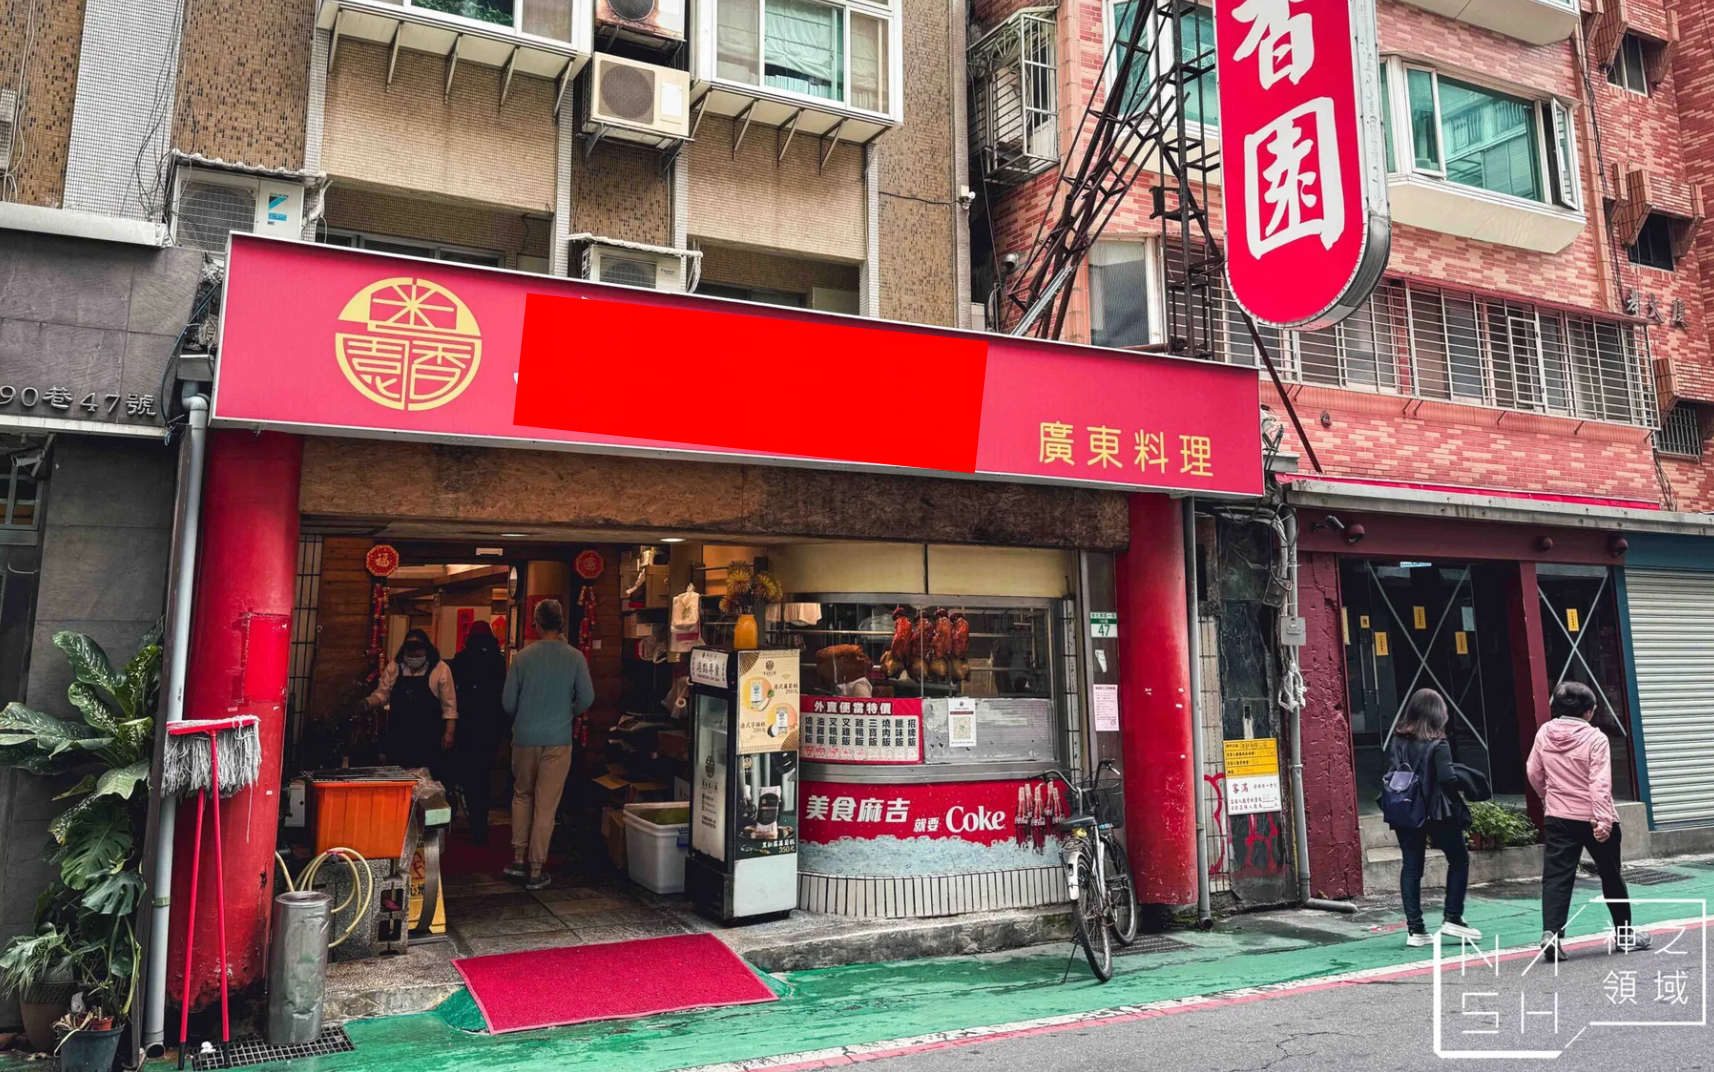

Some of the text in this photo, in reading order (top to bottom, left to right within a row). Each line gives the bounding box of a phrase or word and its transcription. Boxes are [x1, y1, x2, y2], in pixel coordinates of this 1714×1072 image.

[1039, 420, 1214, 477] 廣東料理
[1098, 624, 1110, 637] 47
[814, 700, 892, 714] 外賣便當特價
[907, 719, 916, 747] 招牌飯
[805, 795, 1006, 833] 美食麻吉 就要 Coke
